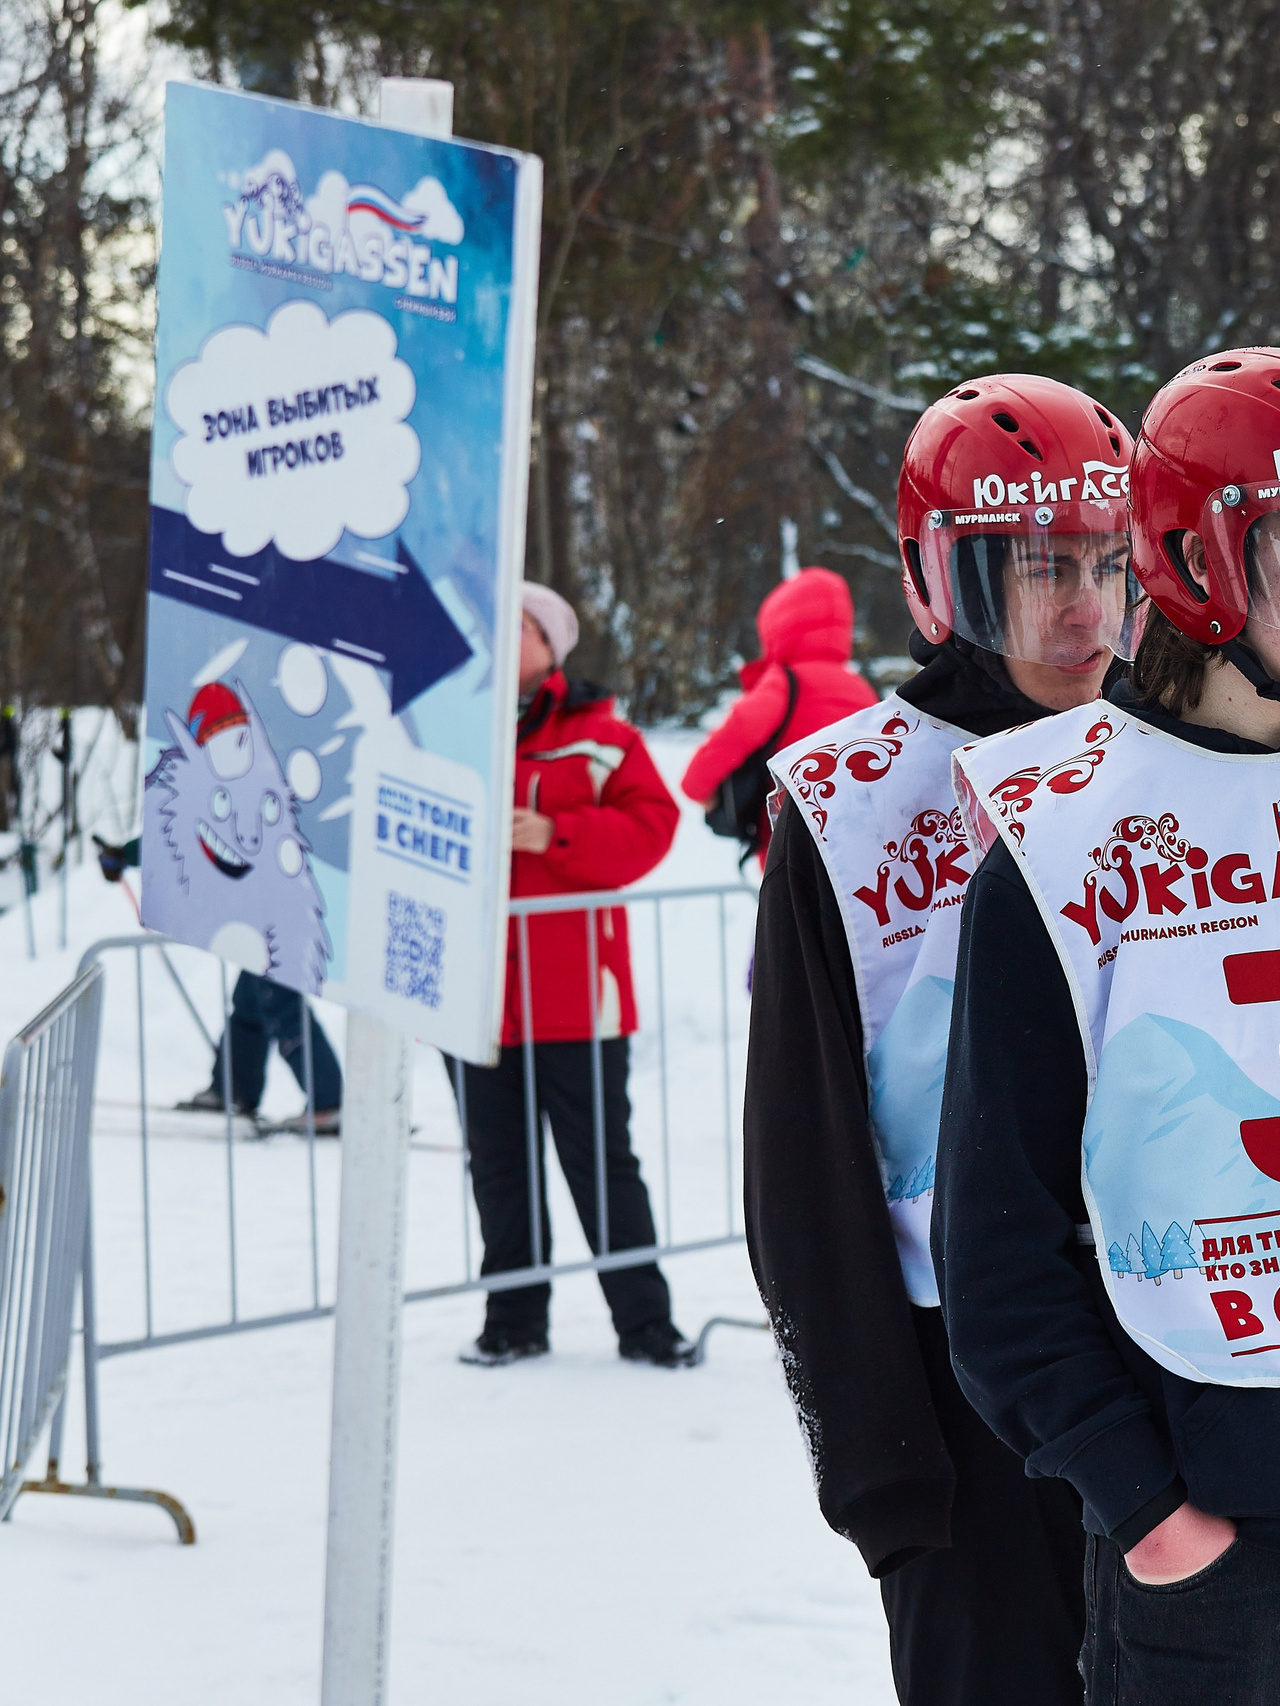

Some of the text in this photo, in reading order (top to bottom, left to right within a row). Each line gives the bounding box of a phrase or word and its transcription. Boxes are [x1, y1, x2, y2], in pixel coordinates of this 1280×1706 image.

[203, 375, 380, 441] ЗОНА ВЫБИТЫХ
[246, 430, 345, 478] ИГРОКОВ
[955, 513, 1021, 525] МУРМАНСК
[418, 799, 471, 838] ТОЛК
[396, 822, 471, 872] СНЕГЕ
[1120, 924, 1196, 944] MURMANSK
[1200, 914, 1259, 935] REGION
[1202, 1234, 1254, 1262] ДЛЯ
[1205, 1262, 1246, 1282] КТО
[1210, 1289, 1265, 1342] В
